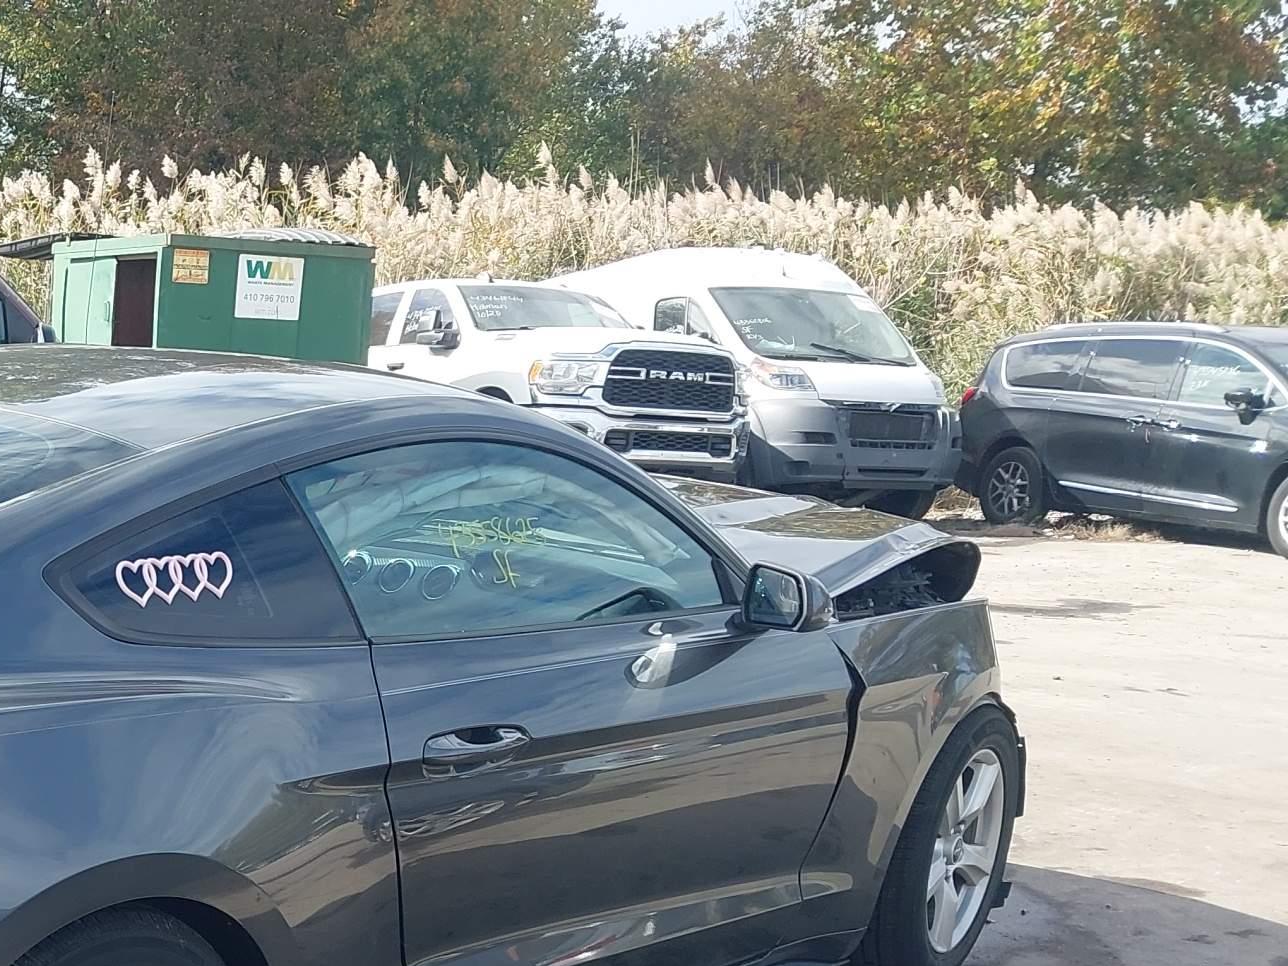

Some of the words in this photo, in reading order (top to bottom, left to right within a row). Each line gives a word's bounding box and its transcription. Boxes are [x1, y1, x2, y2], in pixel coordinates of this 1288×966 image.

[246, 259, 296, 280] WM
[243, 293, 259, 301] 410
[259, 293, 274, 303] 796
[275, 294, 295, 304] 7010
[649, 369, 705, 382] RAM
